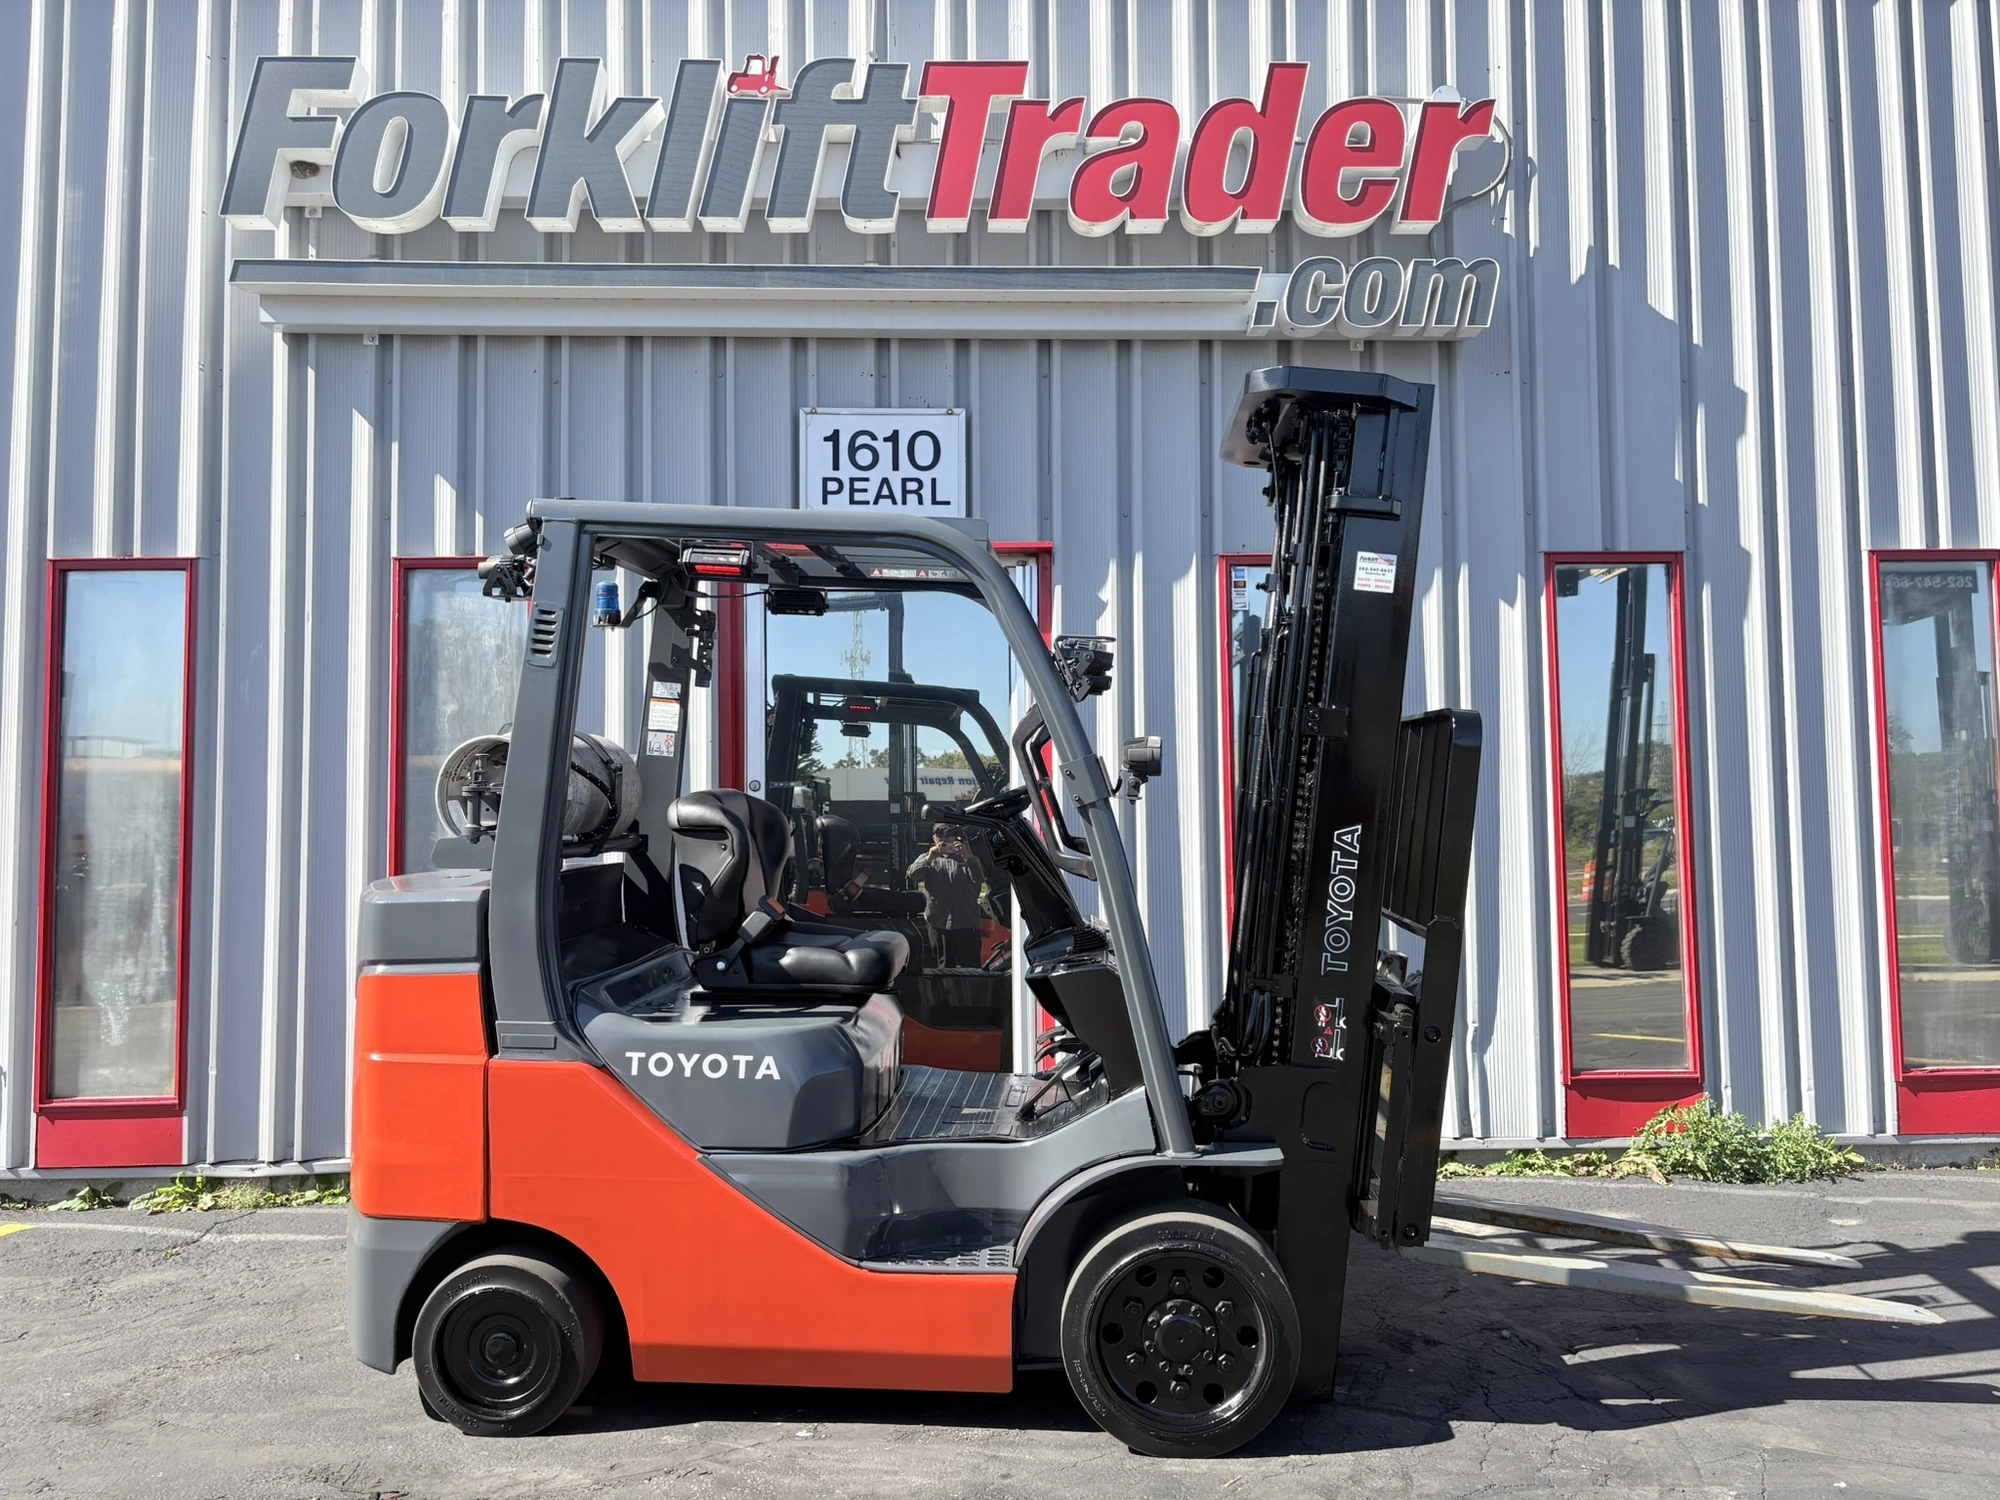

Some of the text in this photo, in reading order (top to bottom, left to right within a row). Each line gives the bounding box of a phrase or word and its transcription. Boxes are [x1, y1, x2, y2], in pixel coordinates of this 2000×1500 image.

[1251, 256, 1500, 328] .com
[823, 429, 941, 471] 1610
[822, 477, 951, 505] PEARL
[1321, 823, 1362, 976] TOYOTA
[625, 1052, 781, 1080] TOYOTA
